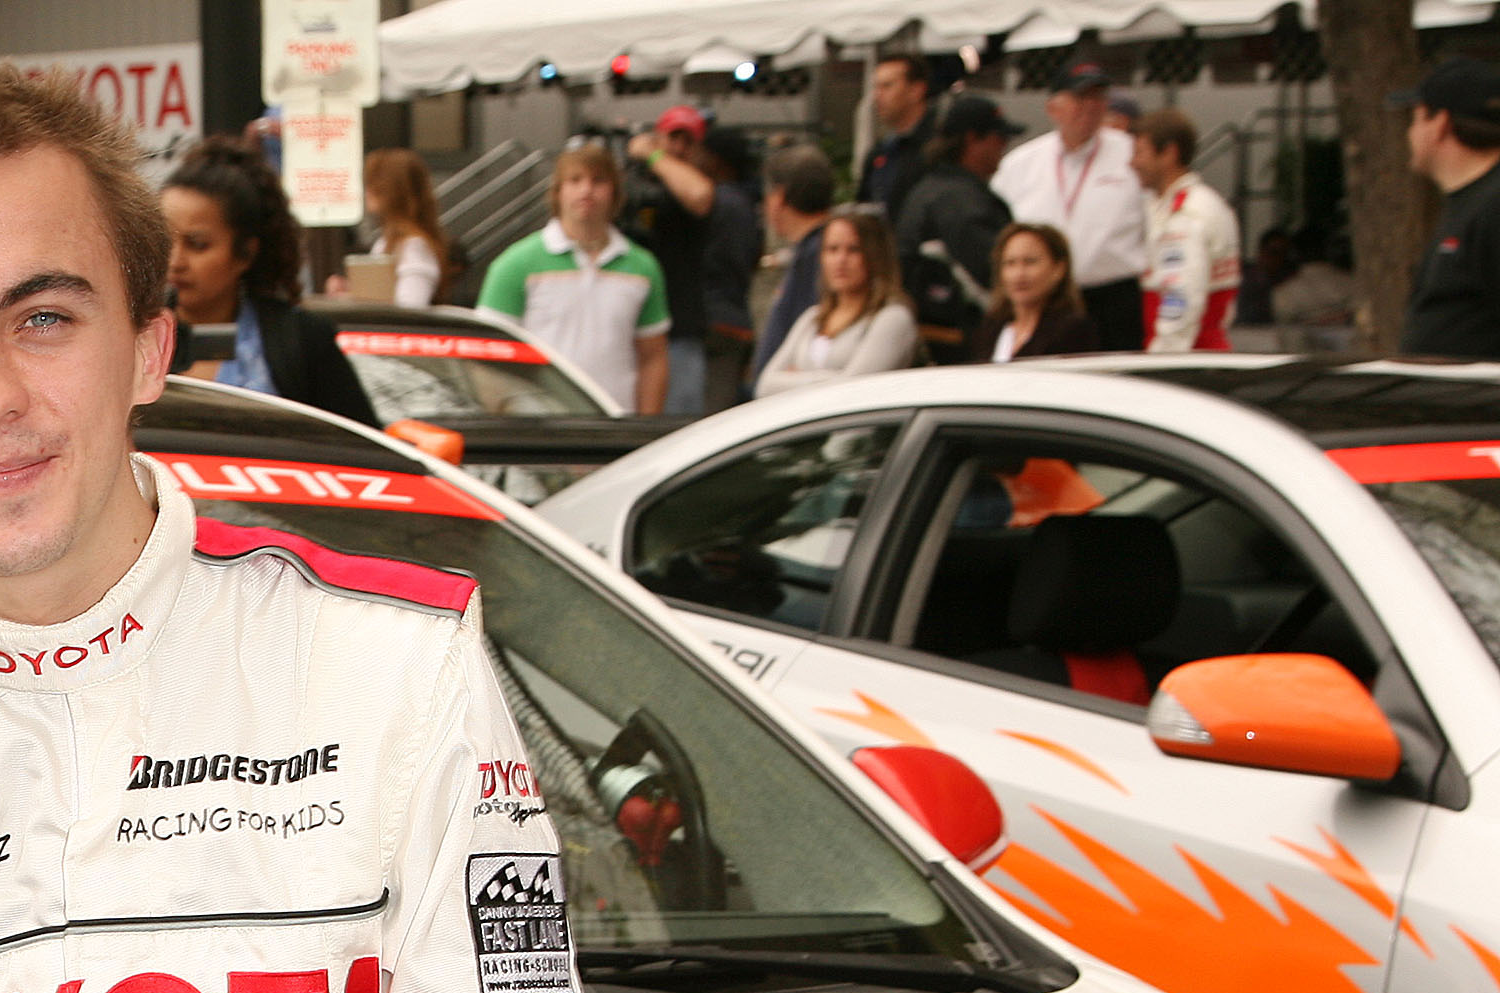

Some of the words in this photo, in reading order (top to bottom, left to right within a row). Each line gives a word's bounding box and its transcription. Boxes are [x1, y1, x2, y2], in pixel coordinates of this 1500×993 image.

[126, 743, 340, 791] BRIDGESTONE
[116, 807, 232, 843] RACING
[237, 810, 276, 835] FOR
[282, 801, 345, 839] KIDS
[481, 920, 526, 952] FAST
